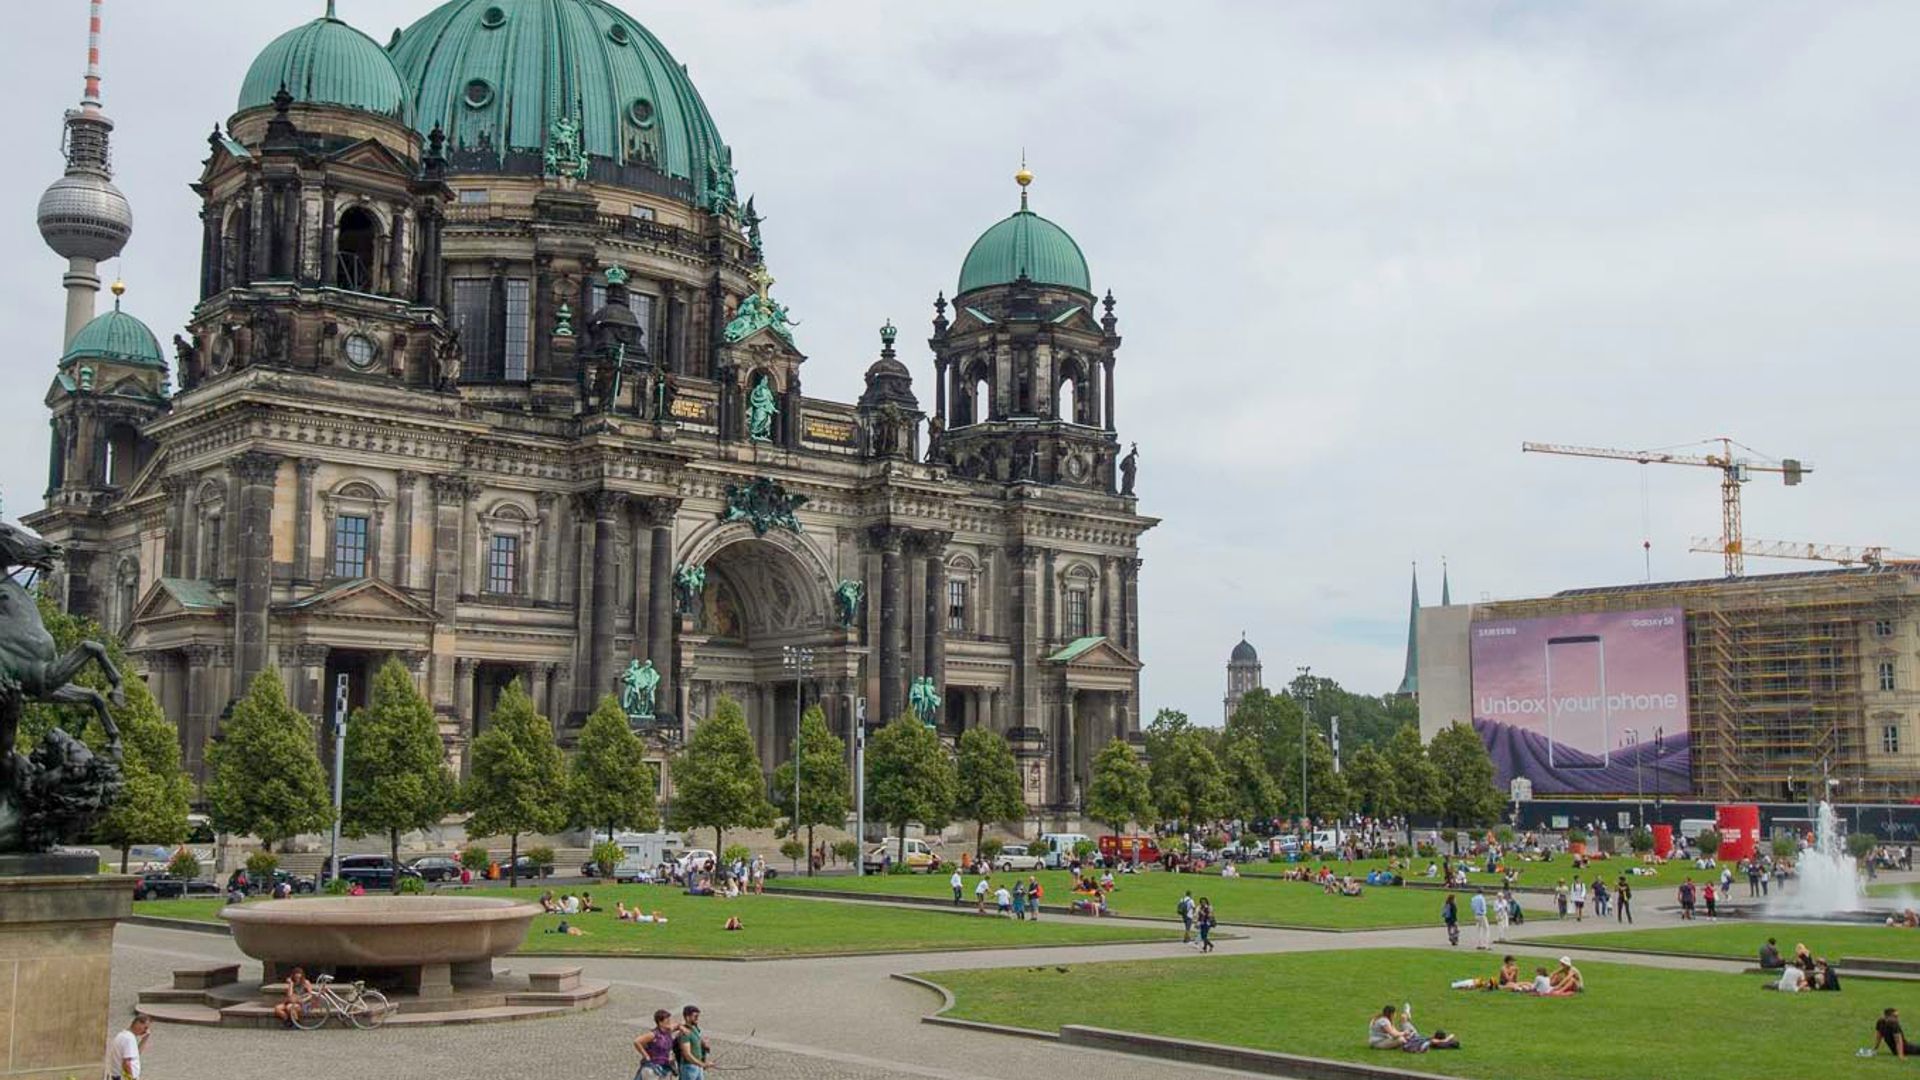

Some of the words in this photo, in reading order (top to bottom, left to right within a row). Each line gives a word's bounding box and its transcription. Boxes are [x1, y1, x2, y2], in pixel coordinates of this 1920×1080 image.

[1631, 618, 1663, 628] Galaxy
[1480, 696, 1546, 715] Unbox
[1551, 696, 1601, 716] your
[1607, 692, 1677, 715] phone
